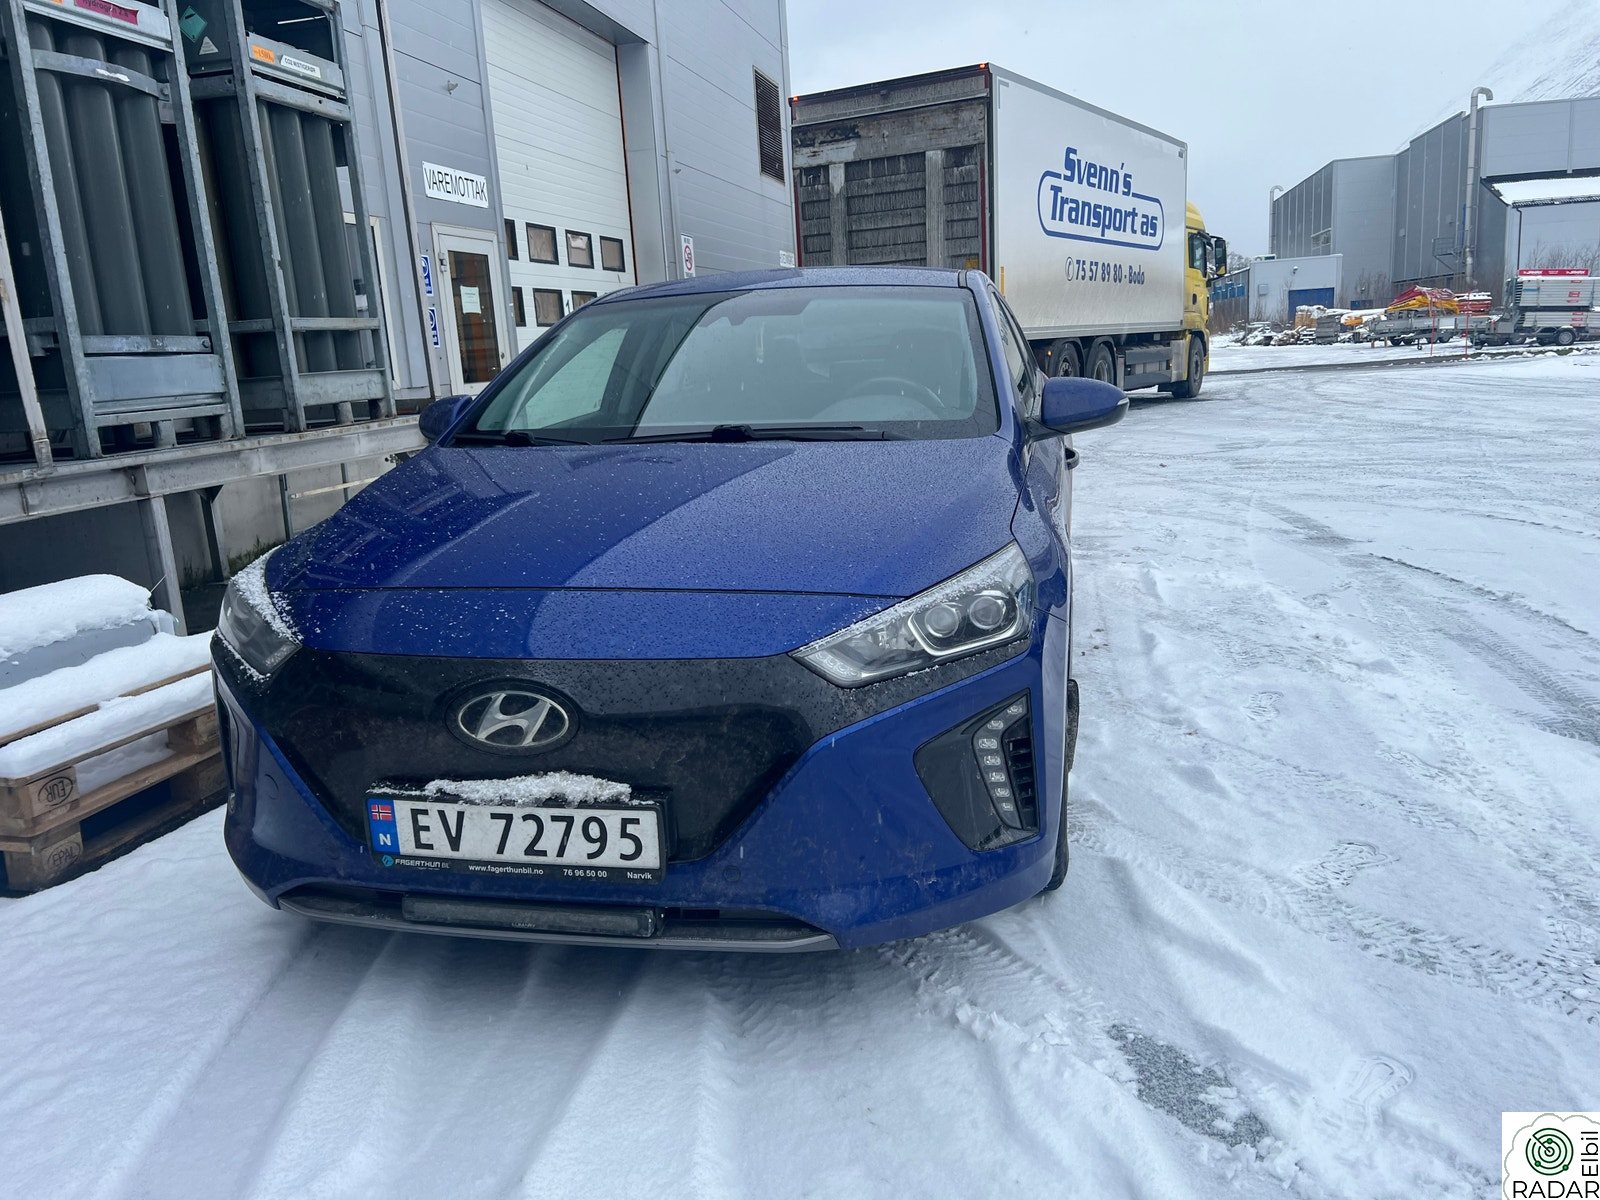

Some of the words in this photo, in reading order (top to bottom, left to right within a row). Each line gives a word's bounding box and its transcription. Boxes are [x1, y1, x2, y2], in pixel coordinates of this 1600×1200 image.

[424, 167, 488, 202] VAREMOTTAK
[1050, 184, 1138, 238] Transport
[1141, 213, 1158, 238] as
[1075, 259, 1086, 281] 75
[1089, 261, 1099, 282] 57
[1101, 262, 1111, 283] 89
[1113, 263, 1123, 284] 80
[45, 780, 66, 803] EUR
[379, 833, 392, 847] N
[410, 808, 465, 852] EV
[490, 812, 643, 862] 72795
[395, 858, 441, 869] FAGERTHUN
[468, 864, 544, 876] www.fagerthunbil.no
[563, 868, 573, 877] 76
[574, 869, 585, 878] 96
[586, 870, 596, 878] 50
[597, 870, 608, 878] 00
[627, 871, 653, 880] Narvik
